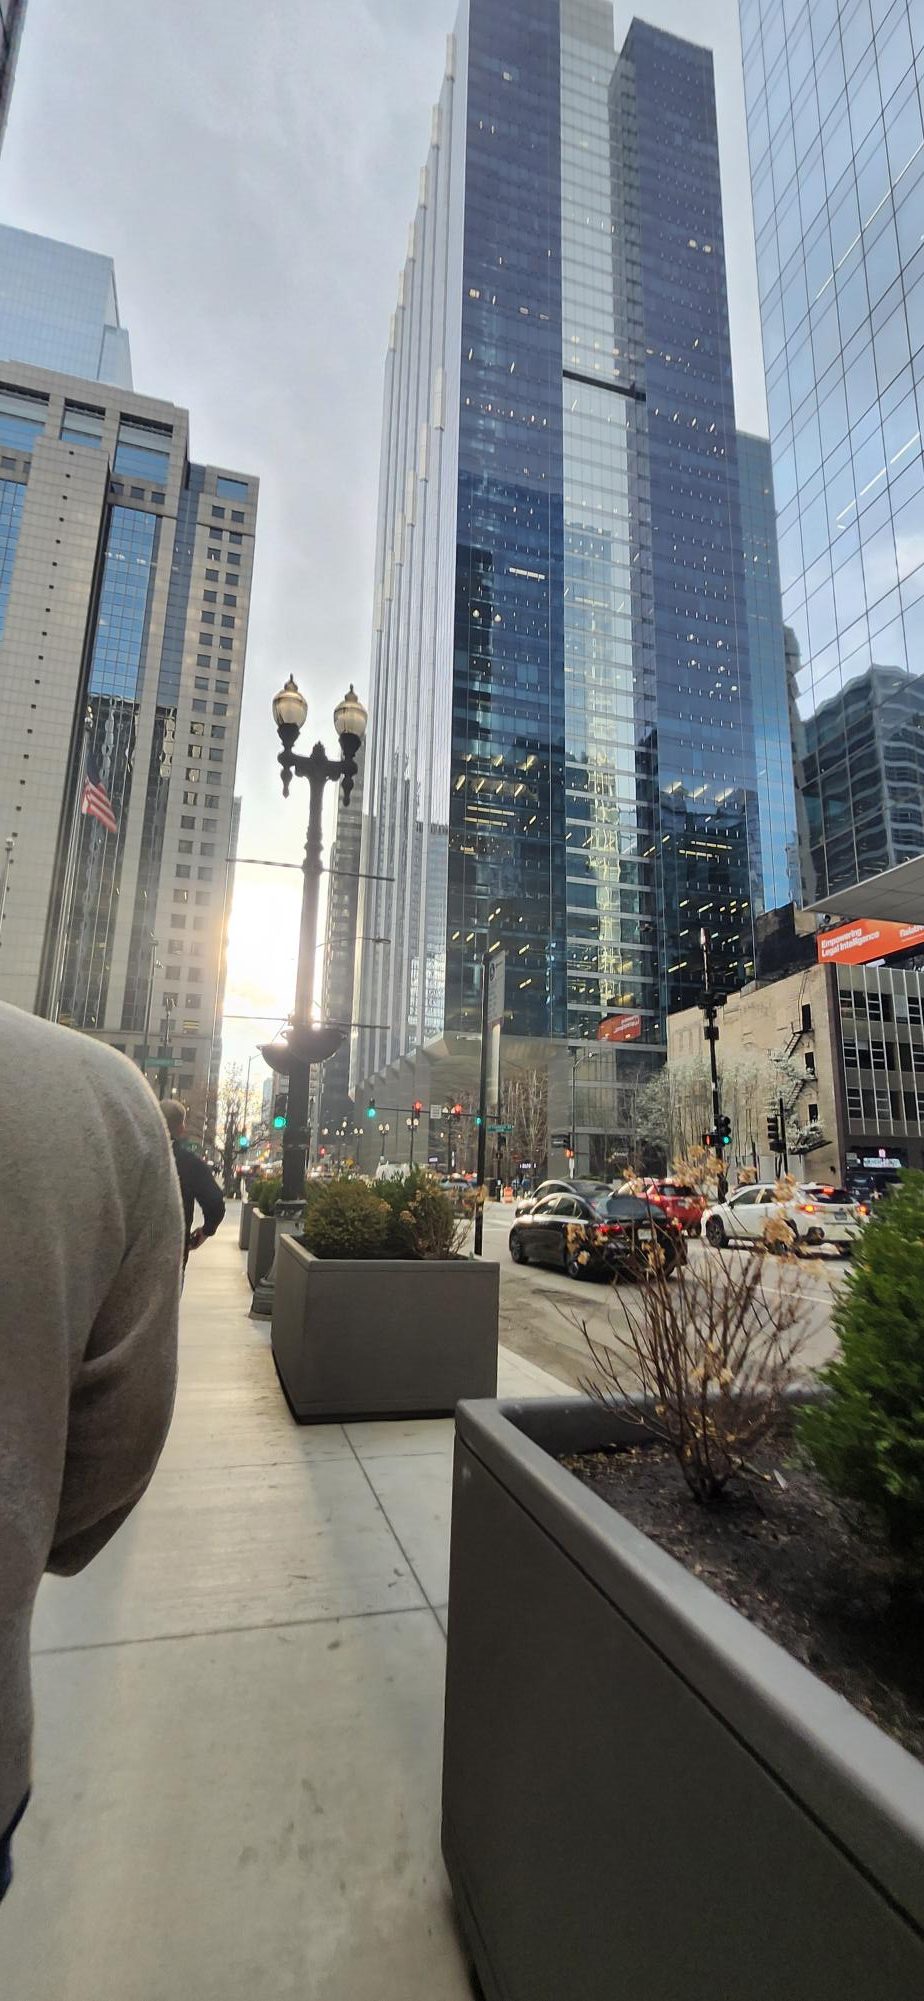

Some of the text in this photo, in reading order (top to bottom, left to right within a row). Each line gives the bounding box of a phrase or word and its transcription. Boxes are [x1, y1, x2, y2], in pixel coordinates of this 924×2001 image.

[821, 928, 862, 949] Empowering
[821, 930, 880, 957] Legal Intelligence
